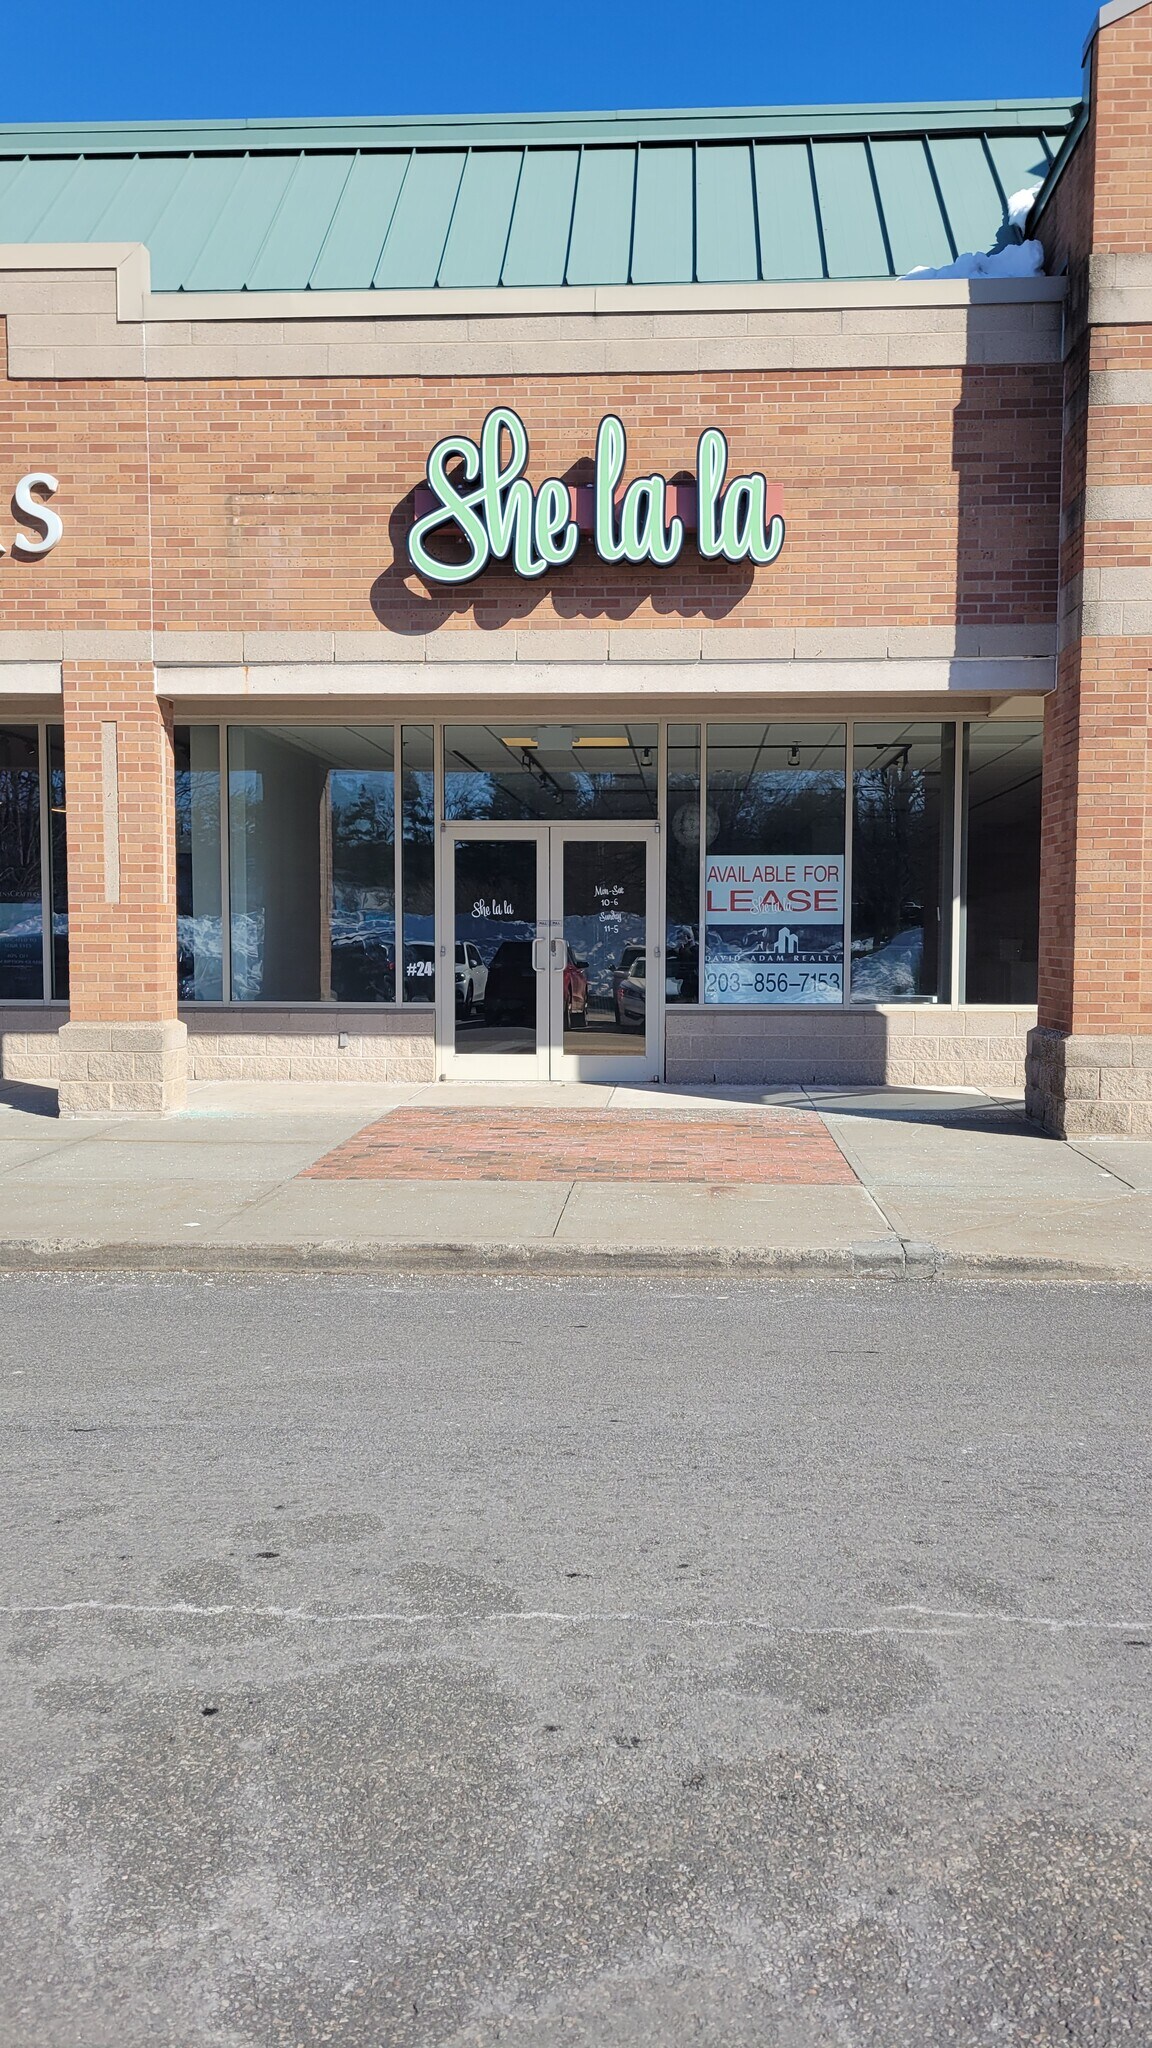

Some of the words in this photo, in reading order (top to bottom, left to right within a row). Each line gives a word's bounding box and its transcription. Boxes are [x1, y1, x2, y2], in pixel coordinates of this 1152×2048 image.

[406, 406, 580, 584] She
[595, 414, 684, 567] la
[697, 427, 785, 567] la
[707, 866, 796, 882] AVAILABLE
[804, 866, 839, 882] FOR
[471, 899, 491, 917] She
[492, 899, 503, 915] la
[503, 900, 514, 915] la
[601, 898, 618, 906] 10-6
[706, 890, 838, 912] LEASE
[599, 910, 621, 922] Sunday
[604, 925, 618, 934] 11-5
[406, 961, 433, 977] #24
[706, 972, 840, 992] 203-856-7153
